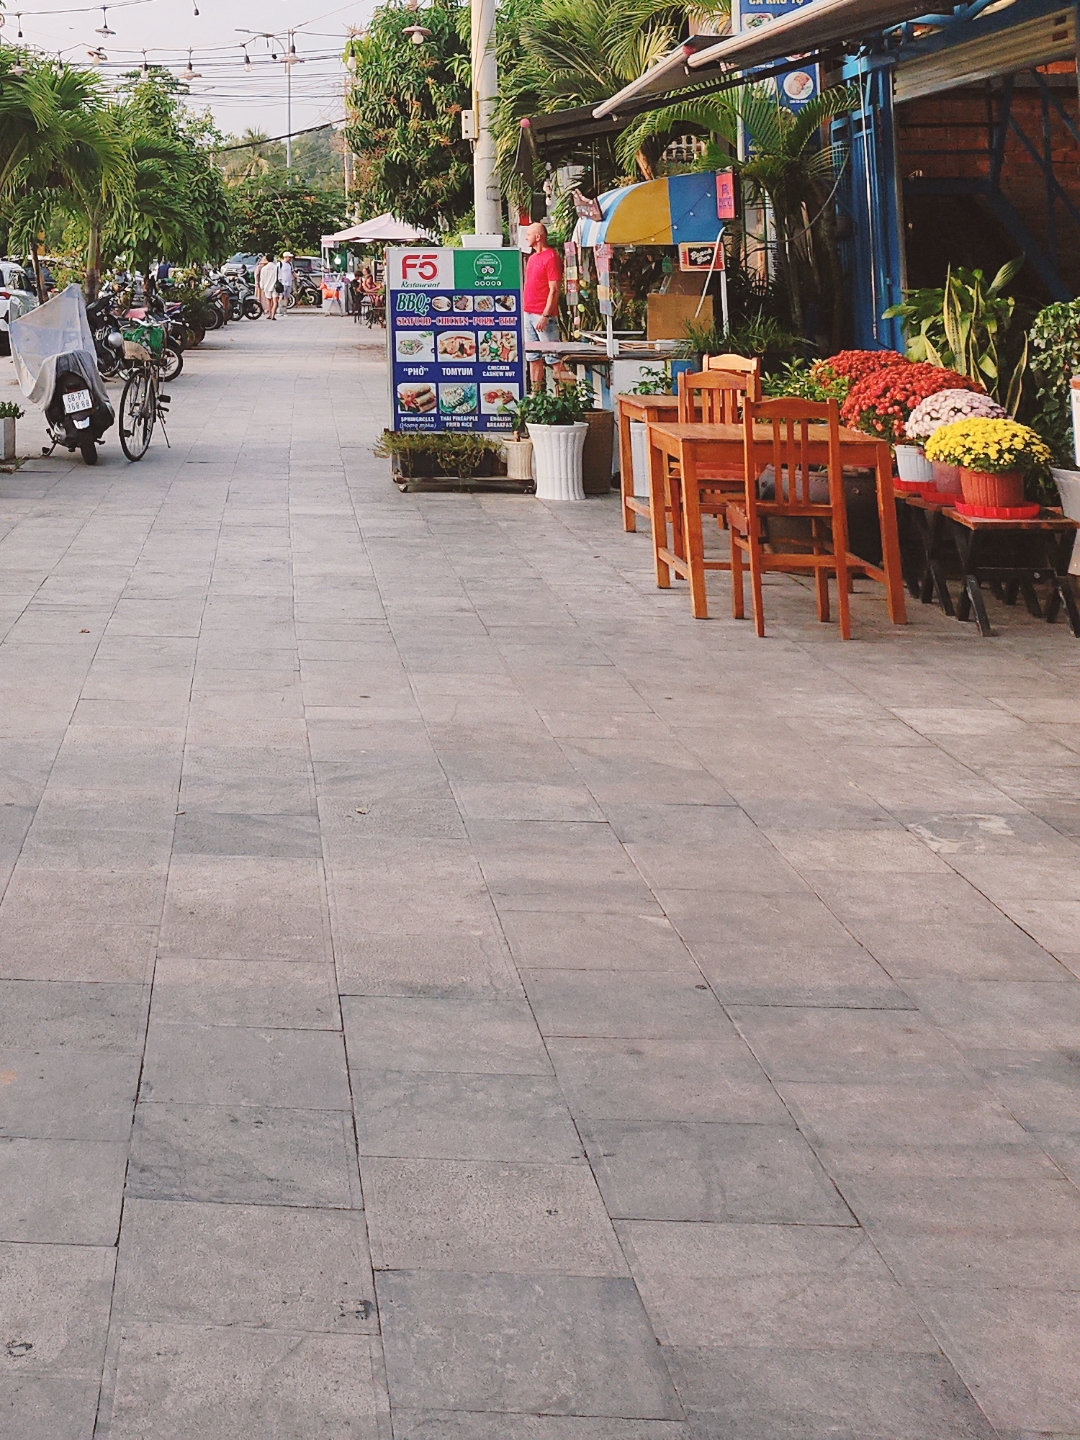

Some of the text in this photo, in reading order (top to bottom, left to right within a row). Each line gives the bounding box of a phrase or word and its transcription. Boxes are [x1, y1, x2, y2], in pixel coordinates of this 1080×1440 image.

[401, 254, 438, 281] F5
[400, 280, 440, 288] Restaurant
[441, 367, 473, 376] TOMYUM
